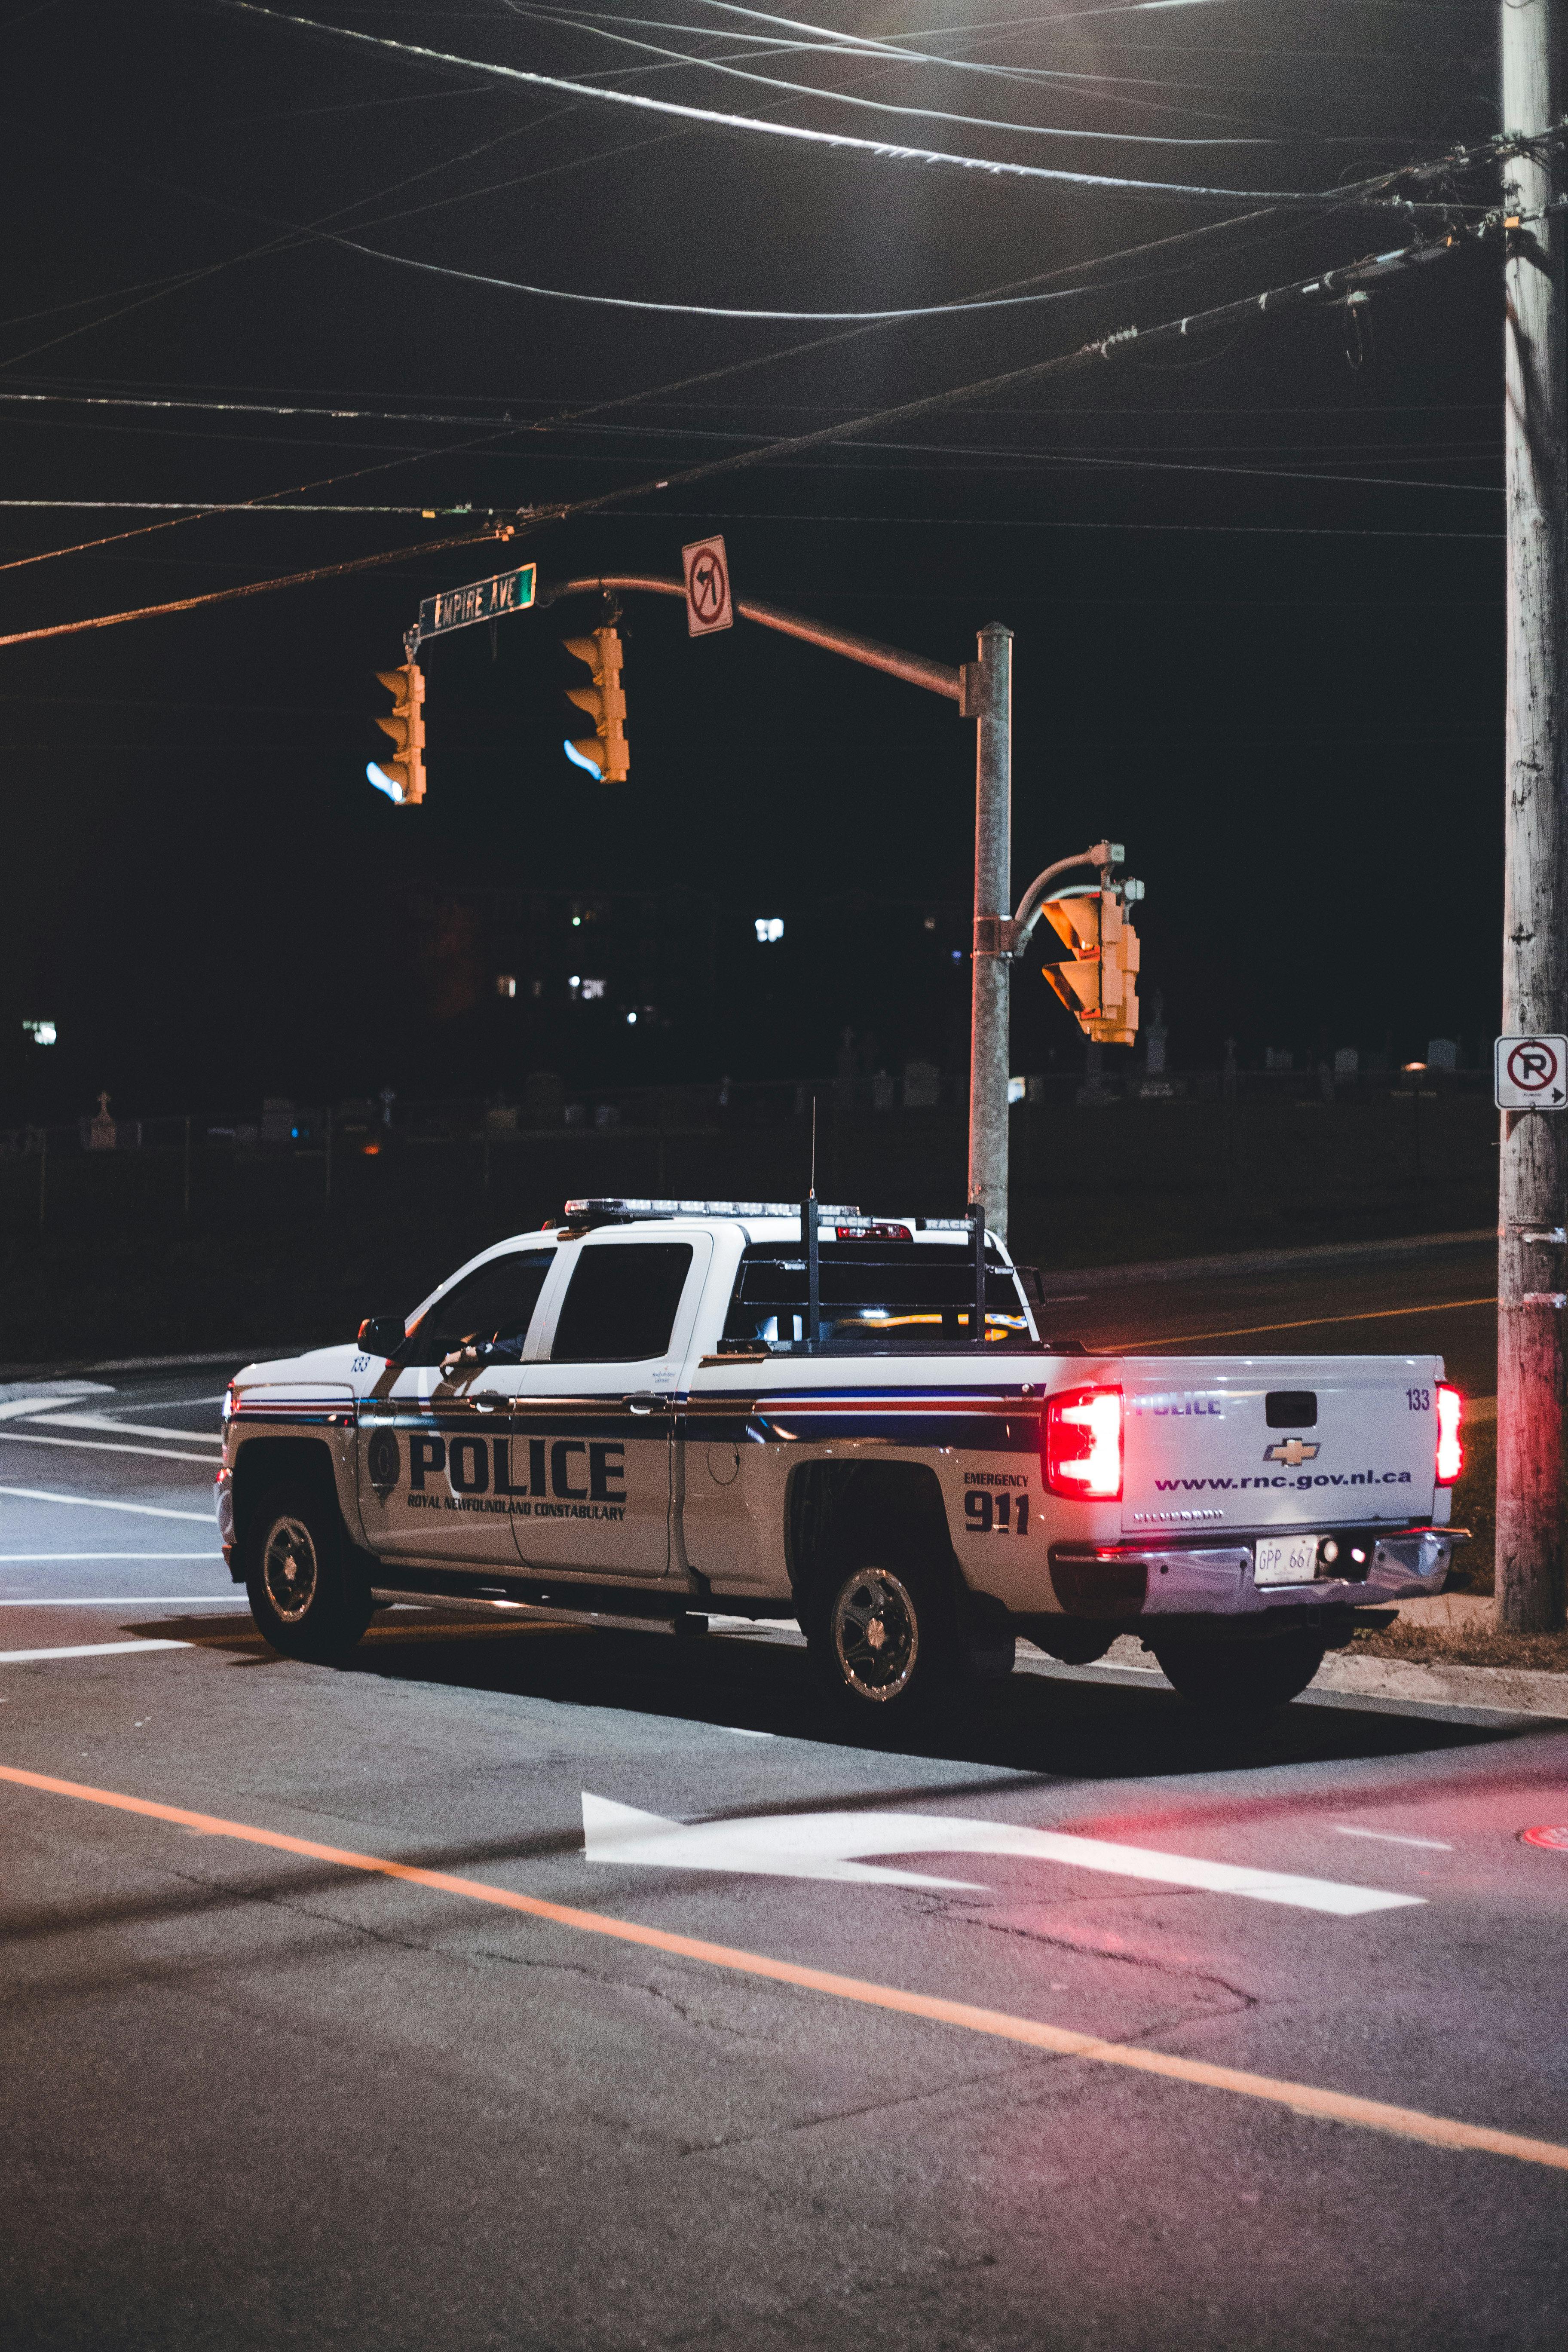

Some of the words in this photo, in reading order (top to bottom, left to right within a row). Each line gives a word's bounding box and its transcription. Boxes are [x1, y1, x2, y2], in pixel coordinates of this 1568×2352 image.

[435, 587, 484, 628] EMPIRE
[489, 576, 516, 611] AVE
[925, 1219, 974, 1231] RACK
[351, 1356, 371, 1372] 133
[1405, 1388, 1430, 1411] 133
[409, 1434, 627, 1503] POLICE
[964, 1472, 1028, 1487] EMERGENCY
[1155, 1470, 1412, 1491] www.rnc.gov.nl.ca
[407, 1494, 441, 1509] ROYAL
[444, 1497, 531, 1516] NEWFOUNDLAND
[535, 1504, 627, 1521] CONSTABULARY
[964, 1489, 1029, 1535] 911
[1259, 1548, 1282, 1570] GPP
[1289, 1547, 1313, 1568] 667
